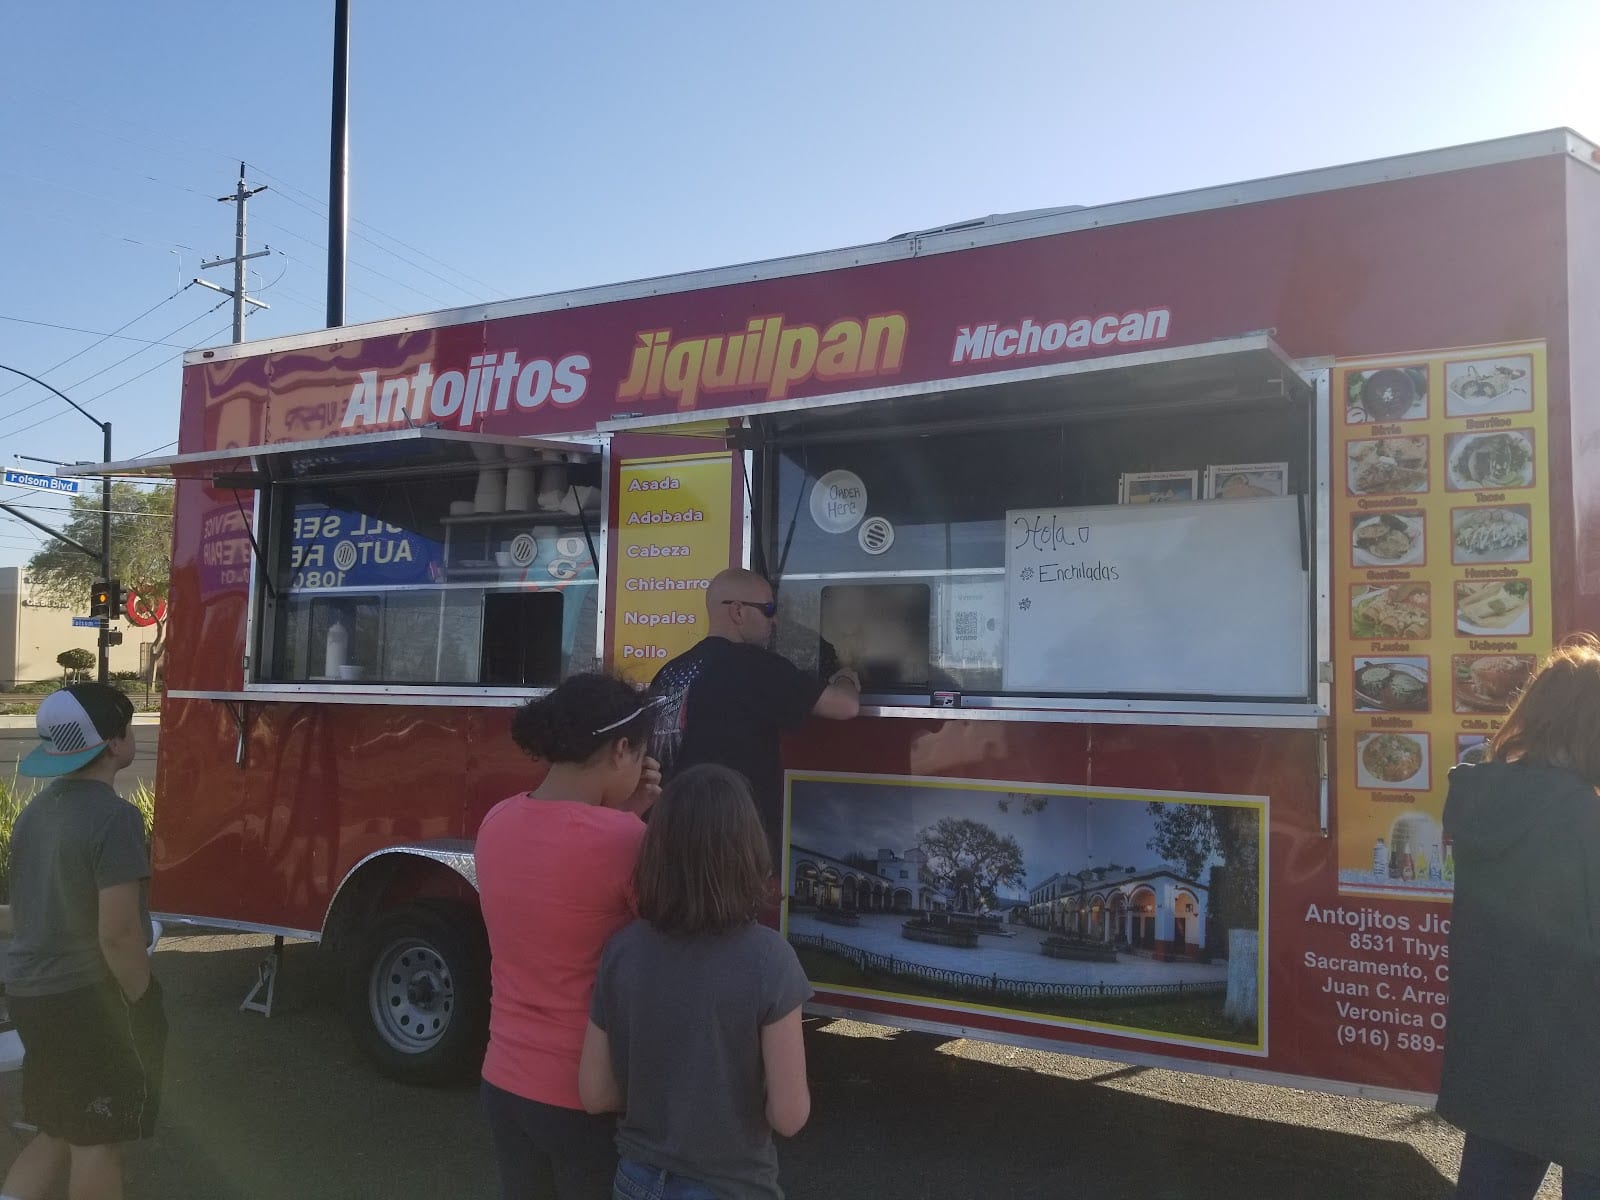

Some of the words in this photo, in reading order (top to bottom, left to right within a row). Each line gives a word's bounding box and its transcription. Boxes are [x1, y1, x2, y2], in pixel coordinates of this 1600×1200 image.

[341, 351, 591, 428] Antojitos
[617, 314, 907, 407] Jiquilpan
[952, 309, 1170, 362] Michoacan
[1466, 418, 1512, 430] Burritos
[11, 474, 50, 489] Folsom
[51, 480, 73, 492] Blvd
[628, 476, 681, 492] Asada
[1475, 492, 1506, 503] Tacos
[627, 509, 704, 525] Adobada
[827, 502, 857, 518] Here
[1014, 515, 1075, 551] Hola
[626, 544, 691, 558] Cabeza
[1039, 560, 1120, 583] Enchiladas
[624, 611, 697, 627] Nopales
[623, 645, 668, 659] Pollo
[1305, 903, 1411, 932] Antojitos
[1350, 933, 1394, 952] 8531
[1304, 952, 1428, 983] Sacramento,
[1322, 976, 1369, 997] Juan
[1376, 982, 1396, 1000] C.
[1402, 986, 1449, 1006] Arre
[1336, 1001, 1424, 1027] Veronica
[1337, 1025, 1390, 1051] (916)
[1397, 1033, 1444, 1053] 589-
